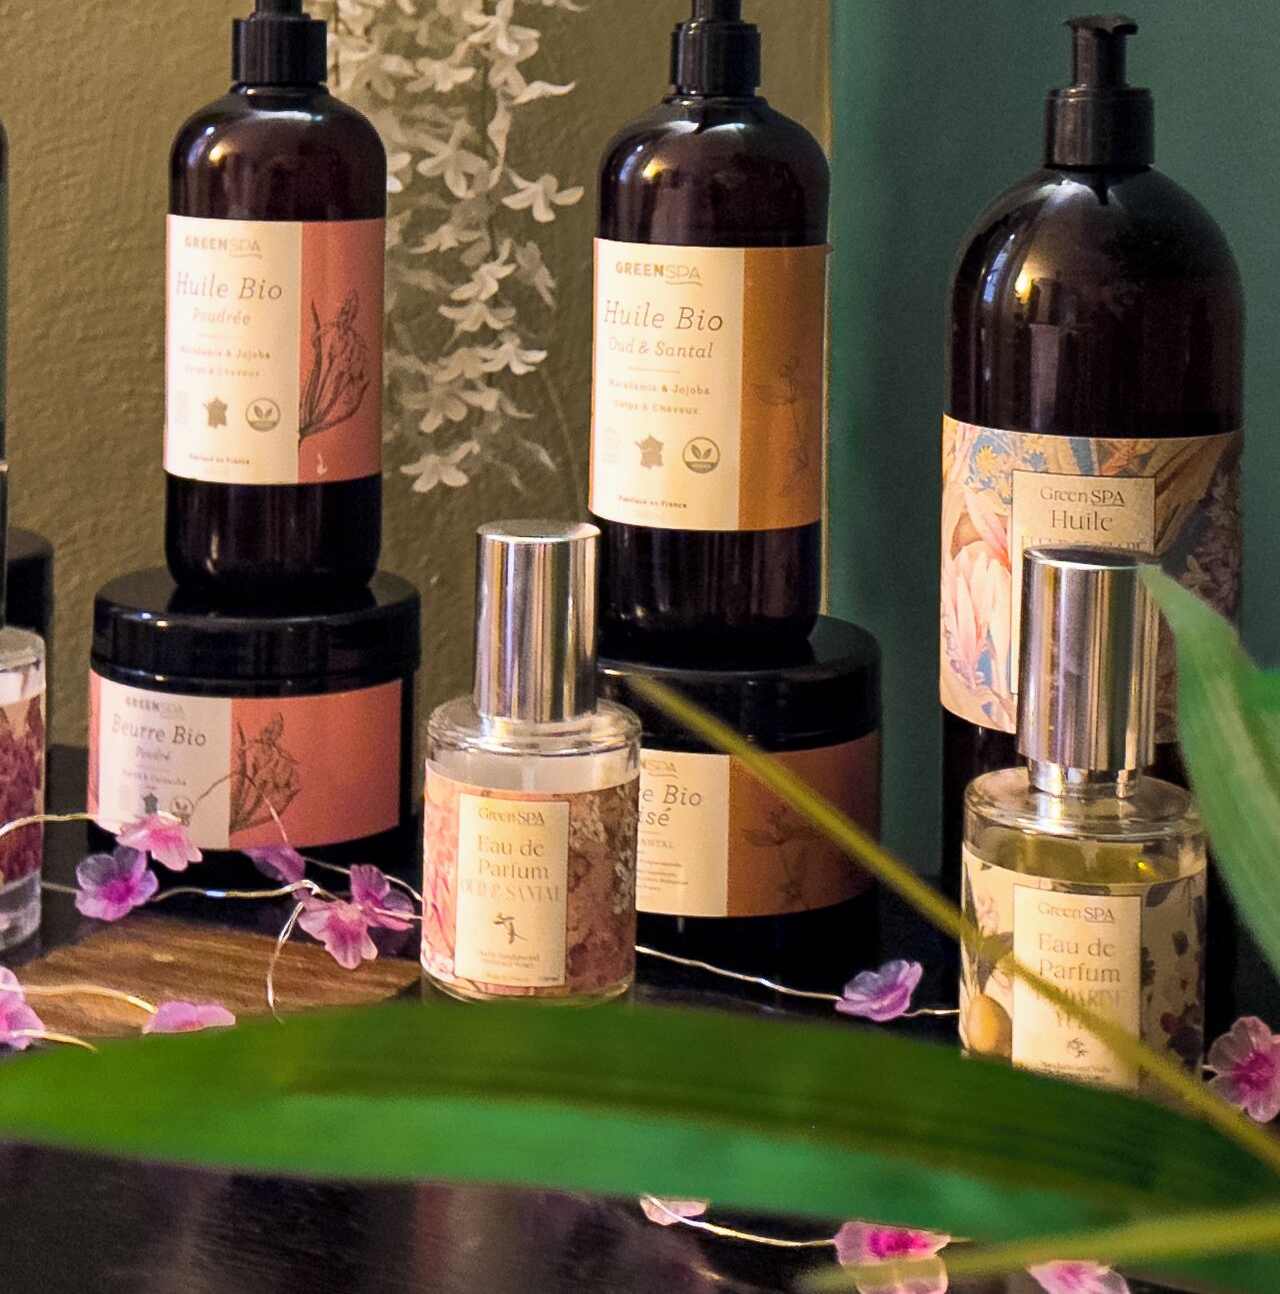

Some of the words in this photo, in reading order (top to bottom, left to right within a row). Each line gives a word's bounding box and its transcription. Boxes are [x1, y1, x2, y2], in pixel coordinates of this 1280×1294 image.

[184, 234, 262, 253] GREENSPA
[615, 260, 702, 280] GREENSPA
[175, 271, 229, 299] Huile
[238, 276, 283, 300] Bio
[192, 307, 251, 326] Poudrée
[604, 300, 665, 330] Huile
[675, 306, 724, 332] Bio
[608, 336, 634, 355] Oud
[638, 341, 650, 355] &
[654, 342, 714, 360] Santal
[671, 384, 711, 397] Jojoba
[651, 402, 699, 415] Cheveux
[1040, 486, 1125, 505] GreenSPA
[1052, 509, 1114, 531] Huile
[111, 713, 167, 742] Beurre
[172, 725, 207, 747] Bio
[663, 784, 703, 807] Bio
[477, 807, 545, 825] GreenSPA
[477, 835, 513, 856] Eau
[520, 839, 545, 857] de
[477, 858, 550, 880] Parfum
[1038, 902, 1116, 921] GreenSPA
[1038, 932, 1080, 955] Eau
[1087, 937, 1116, 958] de
[1039, 958, 1122, 983] Parfum
